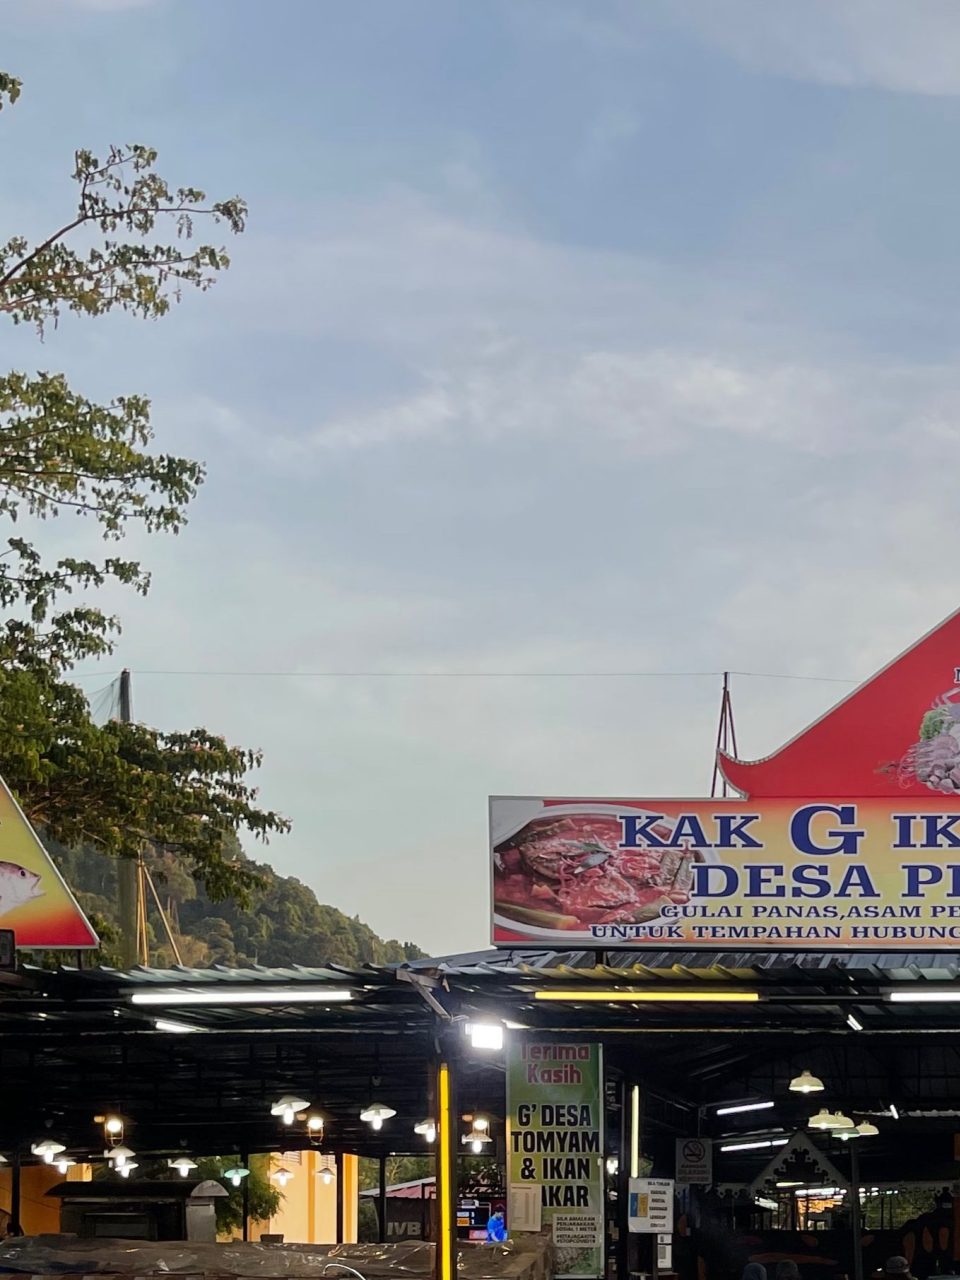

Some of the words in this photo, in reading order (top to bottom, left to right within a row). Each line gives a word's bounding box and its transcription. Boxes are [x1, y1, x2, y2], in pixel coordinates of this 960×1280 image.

[618, 815, 764, 849] KAK
[790, 805, 865, 856] G
[690, 864, 881, 899] DESA
[660, 905, 743, 918] GULAI
[751, 905, 921, 920] PANAS,ASAM
[590, 925, 684, 938] UNTUK
[692, 925, 842, 938] TEMPAHAN
[527, 1063, 582, 1084] Kasih
[511, 1131, 599, 1153] TOMYAM
[521, 1157, 536, 1180] &
[542, 1157, 590, 1180] IKAN
